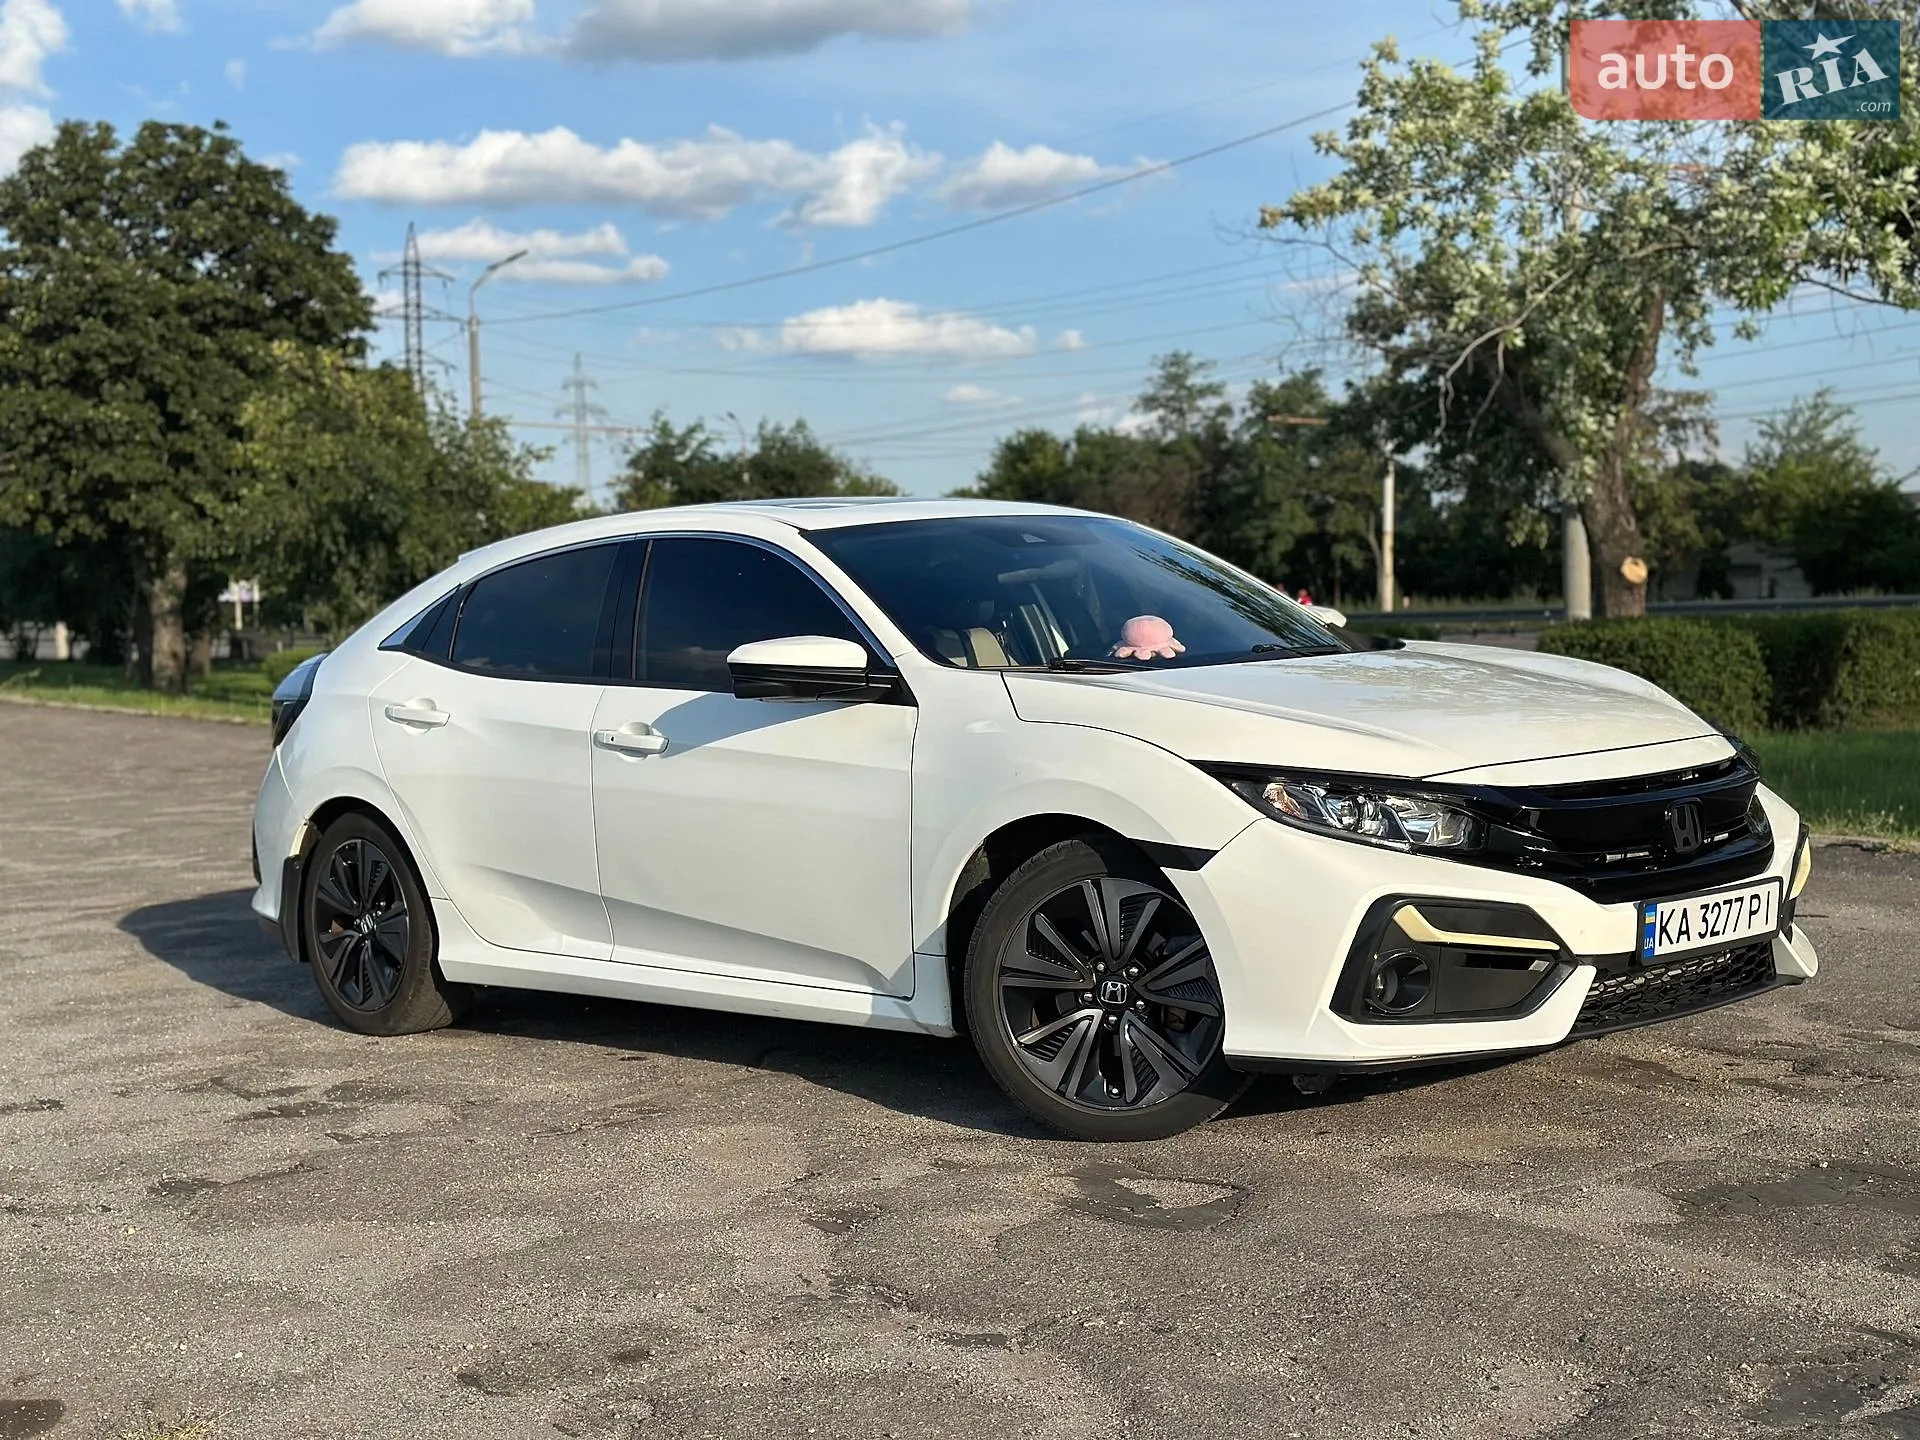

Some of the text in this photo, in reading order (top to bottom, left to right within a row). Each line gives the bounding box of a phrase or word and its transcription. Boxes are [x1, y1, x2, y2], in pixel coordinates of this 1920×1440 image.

[1658, 891, 1771, 947] KA 3277 PI
[1644, 937, 1654, 949] UA
